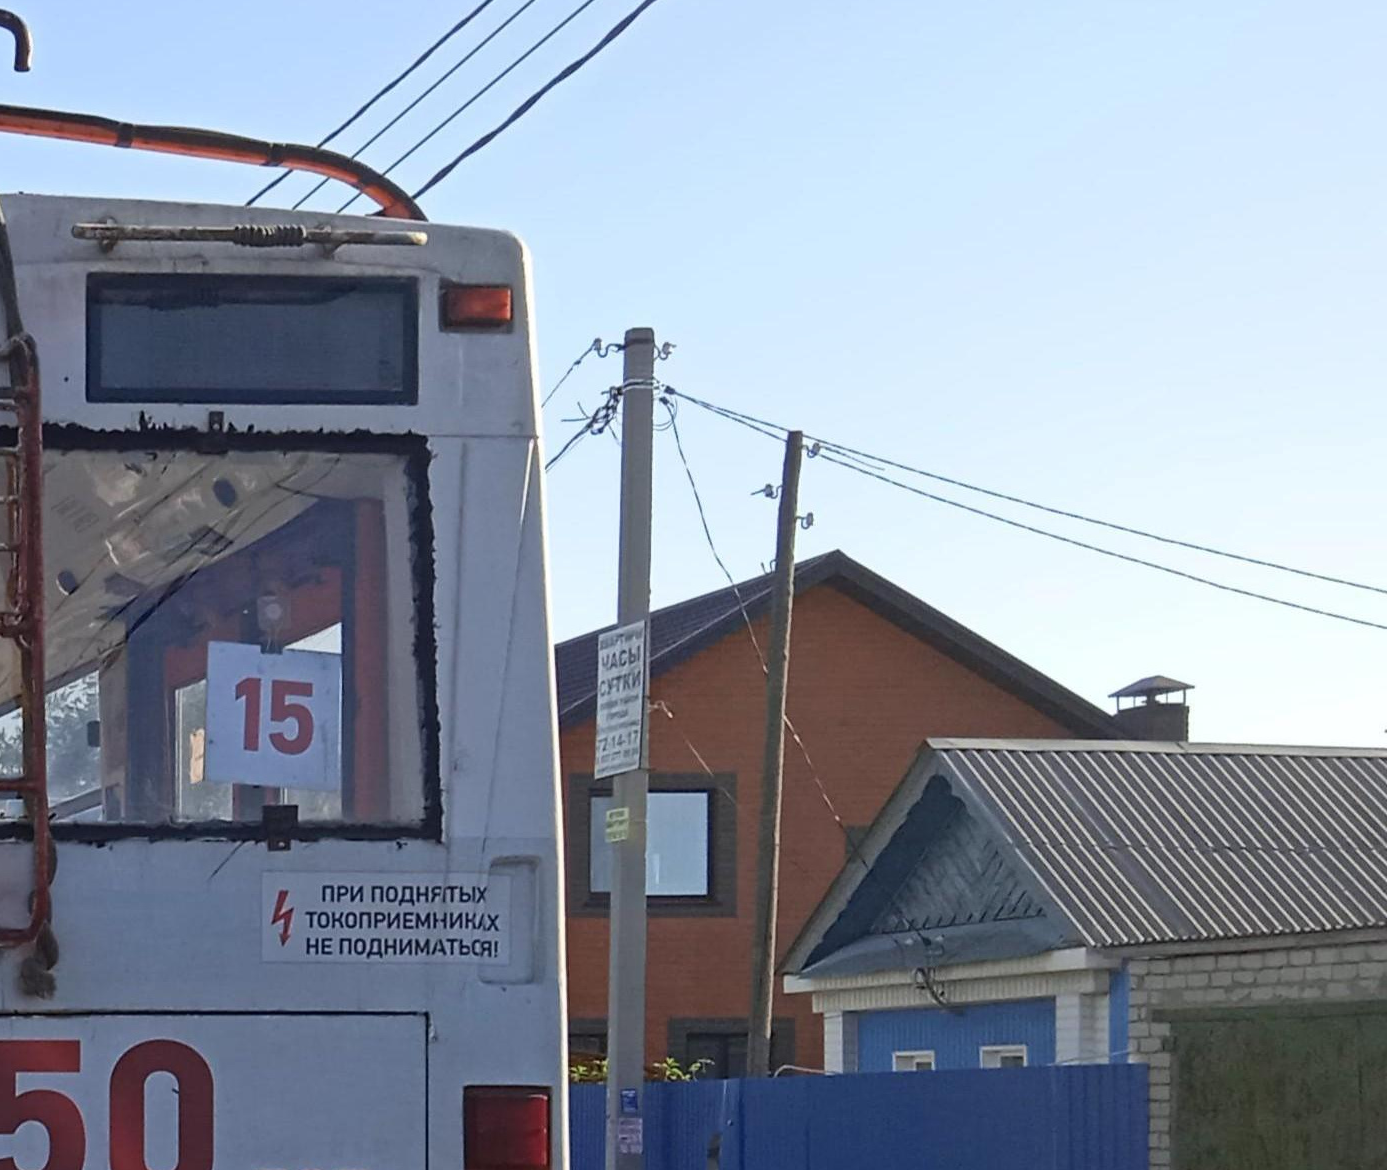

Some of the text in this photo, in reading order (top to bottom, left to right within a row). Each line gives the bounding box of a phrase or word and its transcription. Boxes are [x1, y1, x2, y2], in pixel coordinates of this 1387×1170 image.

[601, 644, 640, 670] ЧАСЫ
[599, 670, 641, 697] СУТКИ
[235, 677, 314, 756] 15
[321, 885, 488, 906] ПРИ ПОДНЯТЫХ
[305, 911, 500, 932] ТОКОПРИЕМНИКАХ
[306, 937, 499, 959] НЕ ПОДНИМАТЬСЯ!
